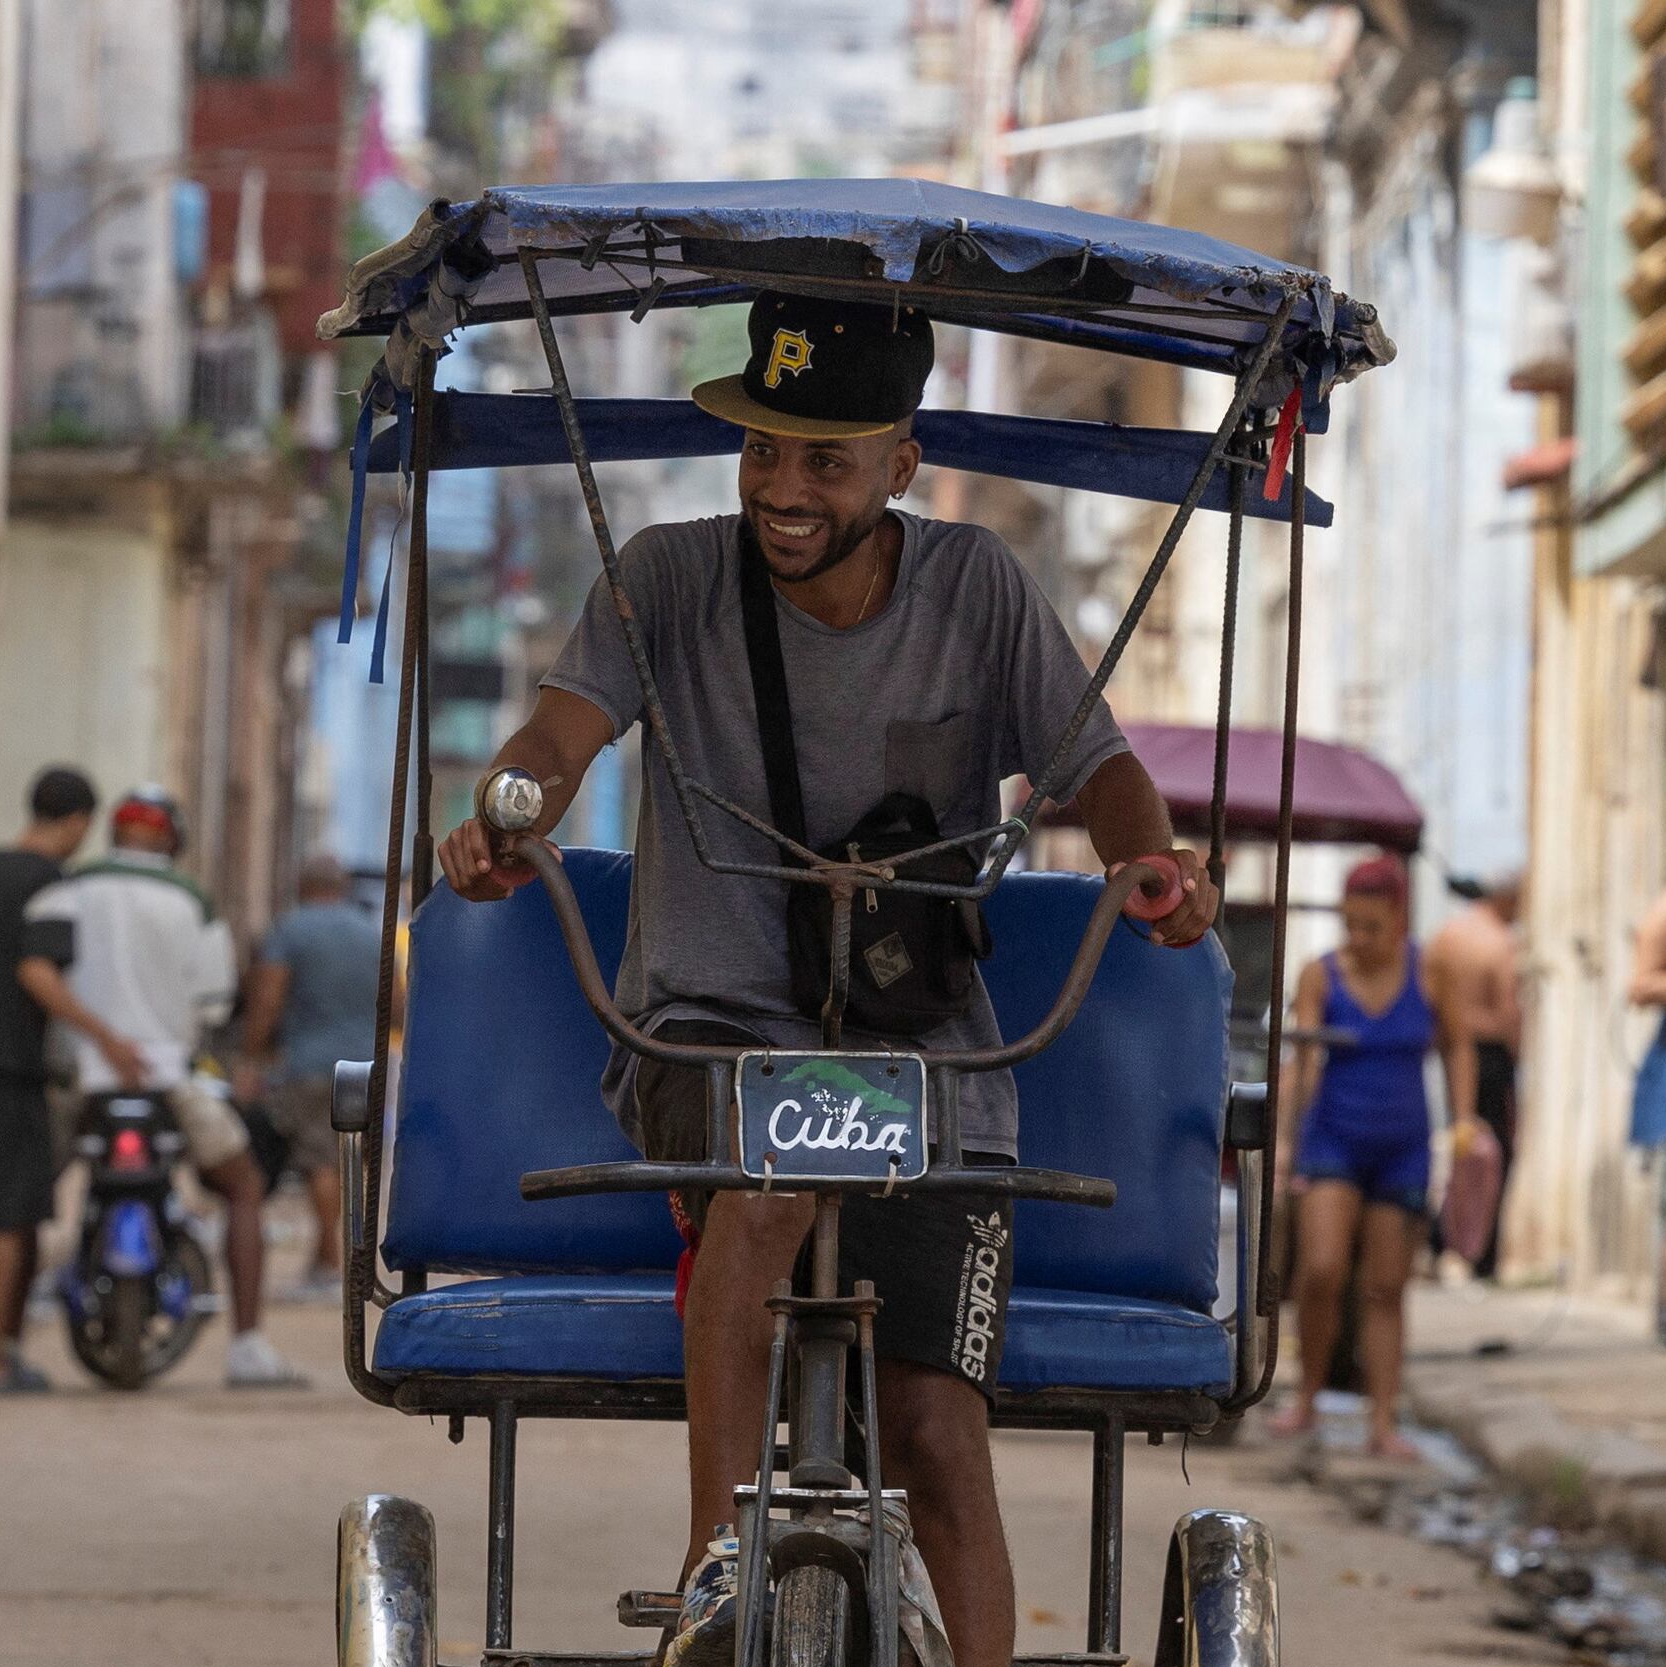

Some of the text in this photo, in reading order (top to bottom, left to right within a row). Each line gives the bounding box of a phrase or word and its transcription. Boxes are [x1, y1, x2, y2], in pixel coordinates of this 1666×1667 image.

[764, 327, 815, 389] P
[768, 1096, 908, 1154] Cuba
[962, 1242, 974, 1270] ACTIVE
[954, 1325, 963, 1338] OF
[961, 1246, 999, 1381] adidas
